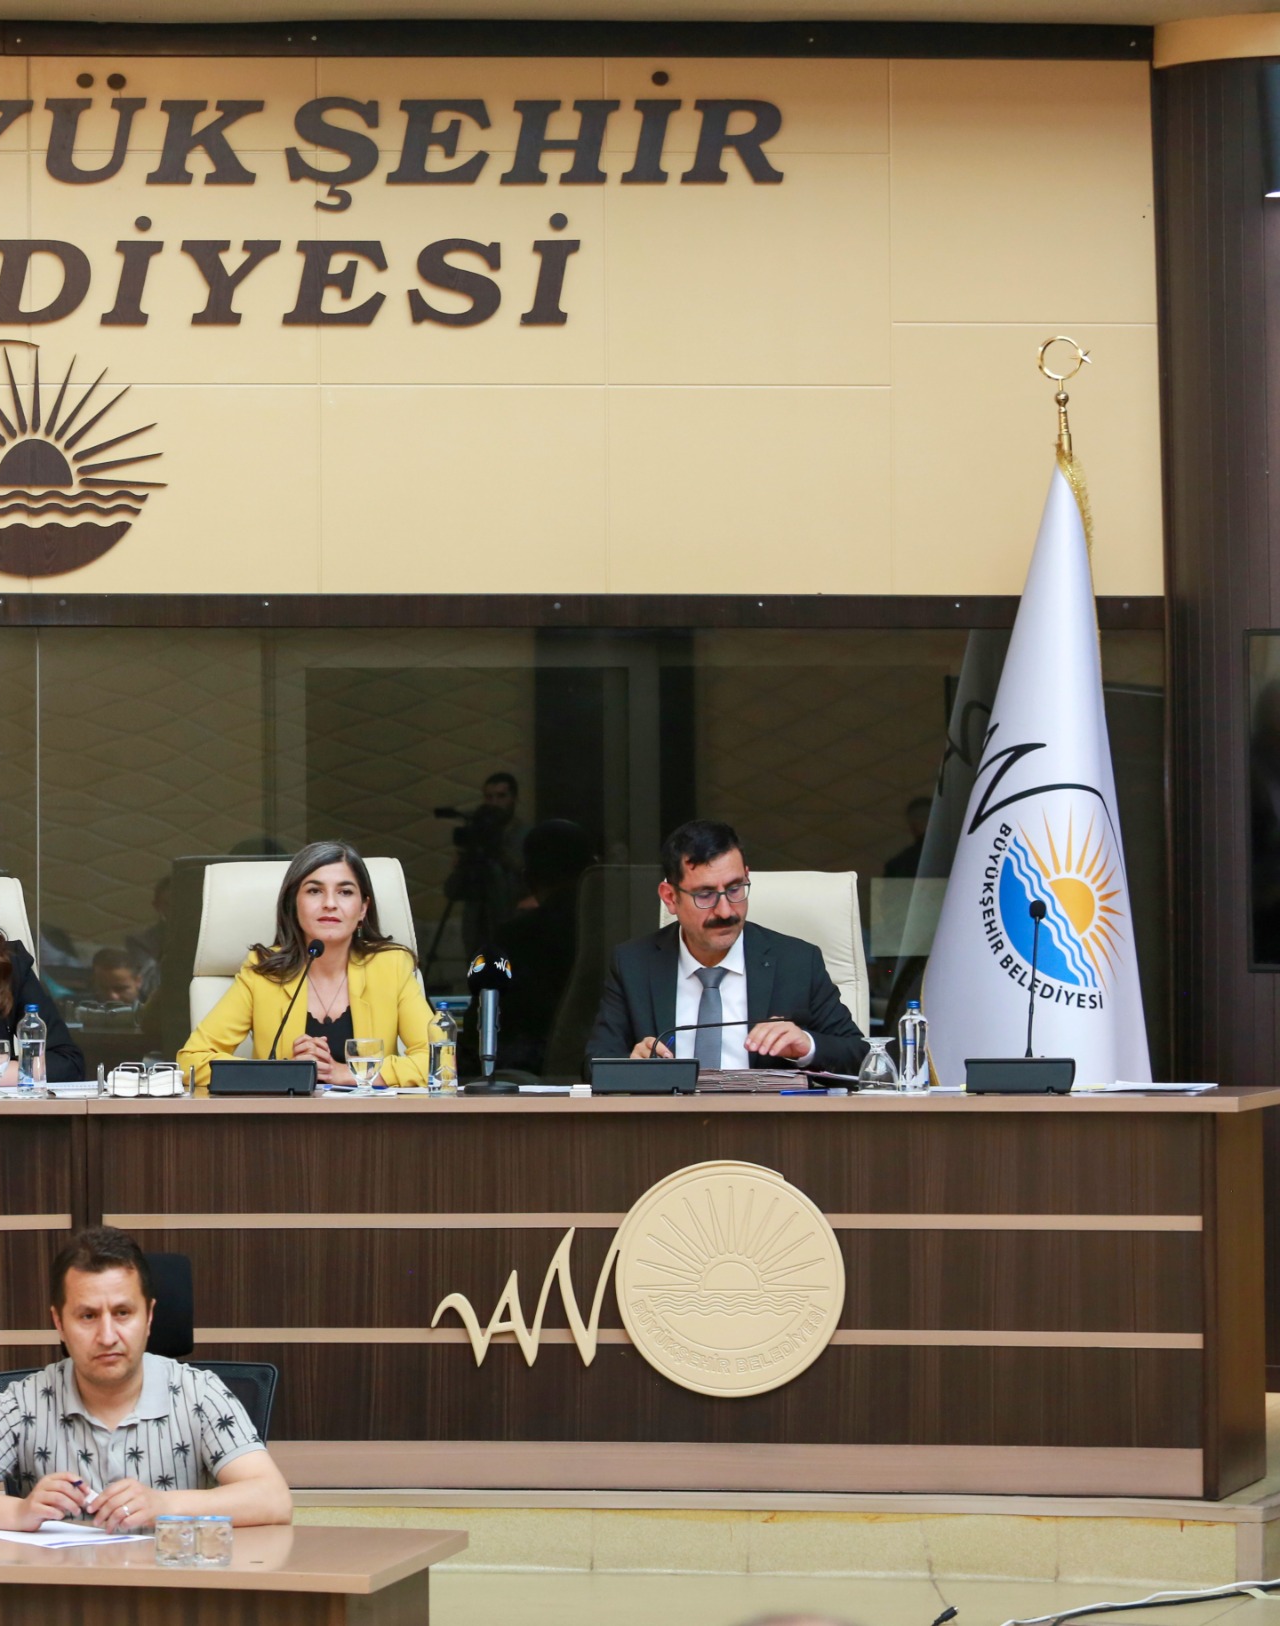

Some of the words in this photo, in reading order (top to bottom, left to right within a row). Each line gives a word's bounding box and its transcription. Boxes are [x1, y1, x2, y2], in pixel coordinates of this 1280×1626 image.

[978, 822, 1013, 955] BÜYÜKŞEHİR
[998, 954, 1104, 1010] BELEDİYESİ
[630, 1300, 730, 1375] BÜYÜKŞEHİR
[735, 1303, 828, 1375] BELEDİYESİ
